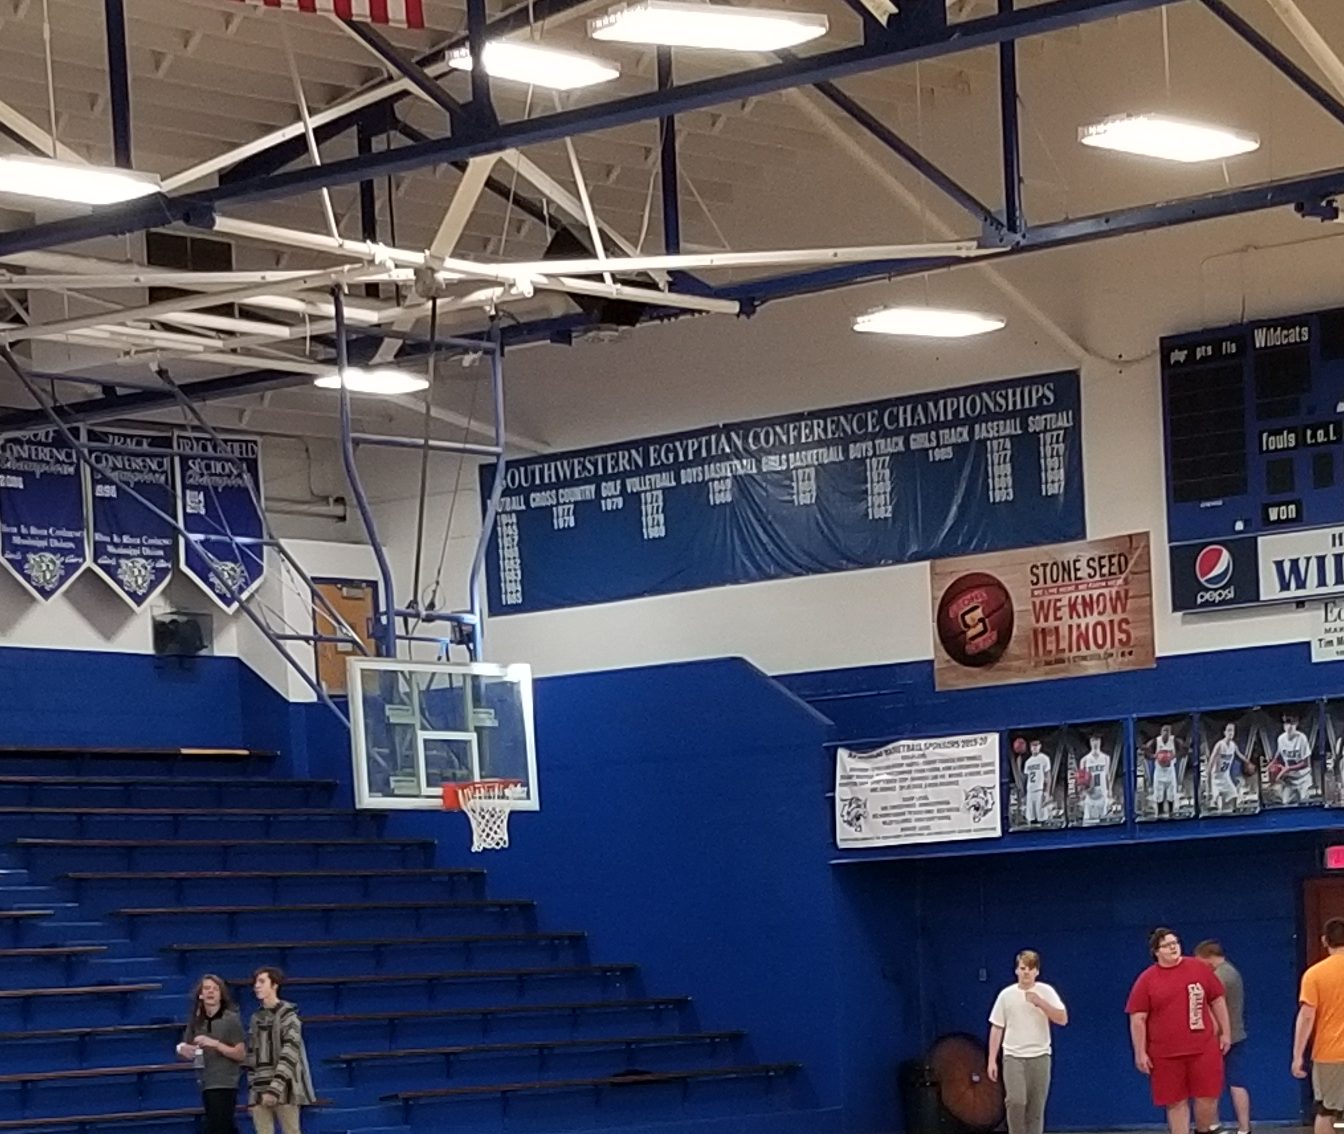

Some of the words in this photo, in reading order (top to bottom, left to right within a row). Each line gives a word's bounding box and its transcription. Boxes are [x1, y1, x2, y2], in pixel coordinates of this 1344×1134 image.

[1253, 324, 1309, 349] Wildcats
[649, 428, 744, 467] EGYPTIAN
[748, 409, 881, 450] CONFERENCE
[883, 382, 1055, 428] CHAMPIONSHIPS
[1027, 409, 1074, 433] SOFTBALL
[1261, 429, 1296, 452] fouls
[1267, 503, 1297, 522] won
[1029, 559, 1084, 587] STONE
[1086, 551, 1130, 579] SEED
[1032, 598, 1064, 626] WE
[1067, 588, 1130, 620] KNOW
[1196, 585, 1235, 607] pepsi
[1031, 617, 1133, 658] ILLINOIS
[1317, 637, 1334, 648] Tim
